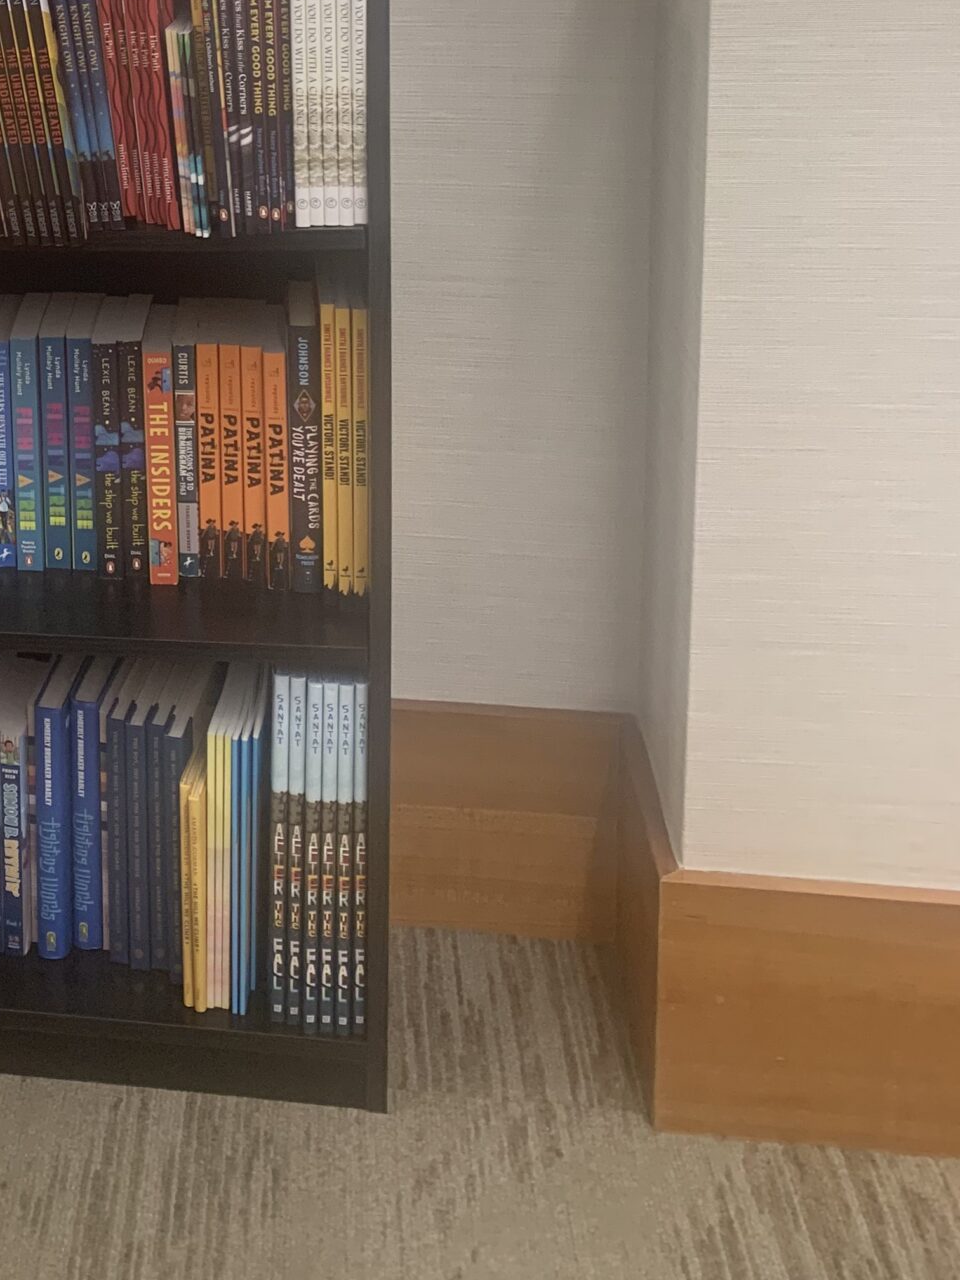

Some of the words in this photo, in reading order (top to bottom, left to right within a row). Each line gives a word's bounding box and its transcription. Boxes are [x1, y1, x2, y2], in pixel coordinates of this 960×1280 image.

[81, 4, 95, 45] KNIGHT
[250, 9, 259, 43] EVERY
[324, 3, 332, 23] YOU
[236, 29, 245, 51] Kiss
[324, 27, 333, 42] DO
[38, 47, 49, 69] THE
[252, 45, 260, 78] GOOD
[325, 45, 333, 72] WITH
[43, 74, 62, 145] UNDEFEATED
[238, 73, 247, 115] Corners
[253, 81, 262, 114] THING
[128, 355, 136, 382] LEXIE
[178, 353, 188, 385] CURTIS
[298, 337, 309, 385] JOHNSON
[128, 388, 136, 412] BEAN
[149, 402, 168, 436] THE
[269, 424, 285, 496] PATINA
[292, 426, 305, 466] YOU'RE
[305, 426, 319, 475] PLAYING
[130, 470, 139, 484] the
[324, 454, 334, 480] STAND!
[126, 487, 142, 506] ship
[150, 445, 172, 531] INSIDERS
[292, 467, 306, 501] DEALT
[309, 478, 317, 491] THE
[132, 508, 138, 521] we
[306, 495, 320, 529] CARDS
[132, 524, 145, 546] built
[312, 704, 320, 754] SANTAT
[307, 833, 319, 905] AFTER
[306, 948, 316, 1001] FALL
